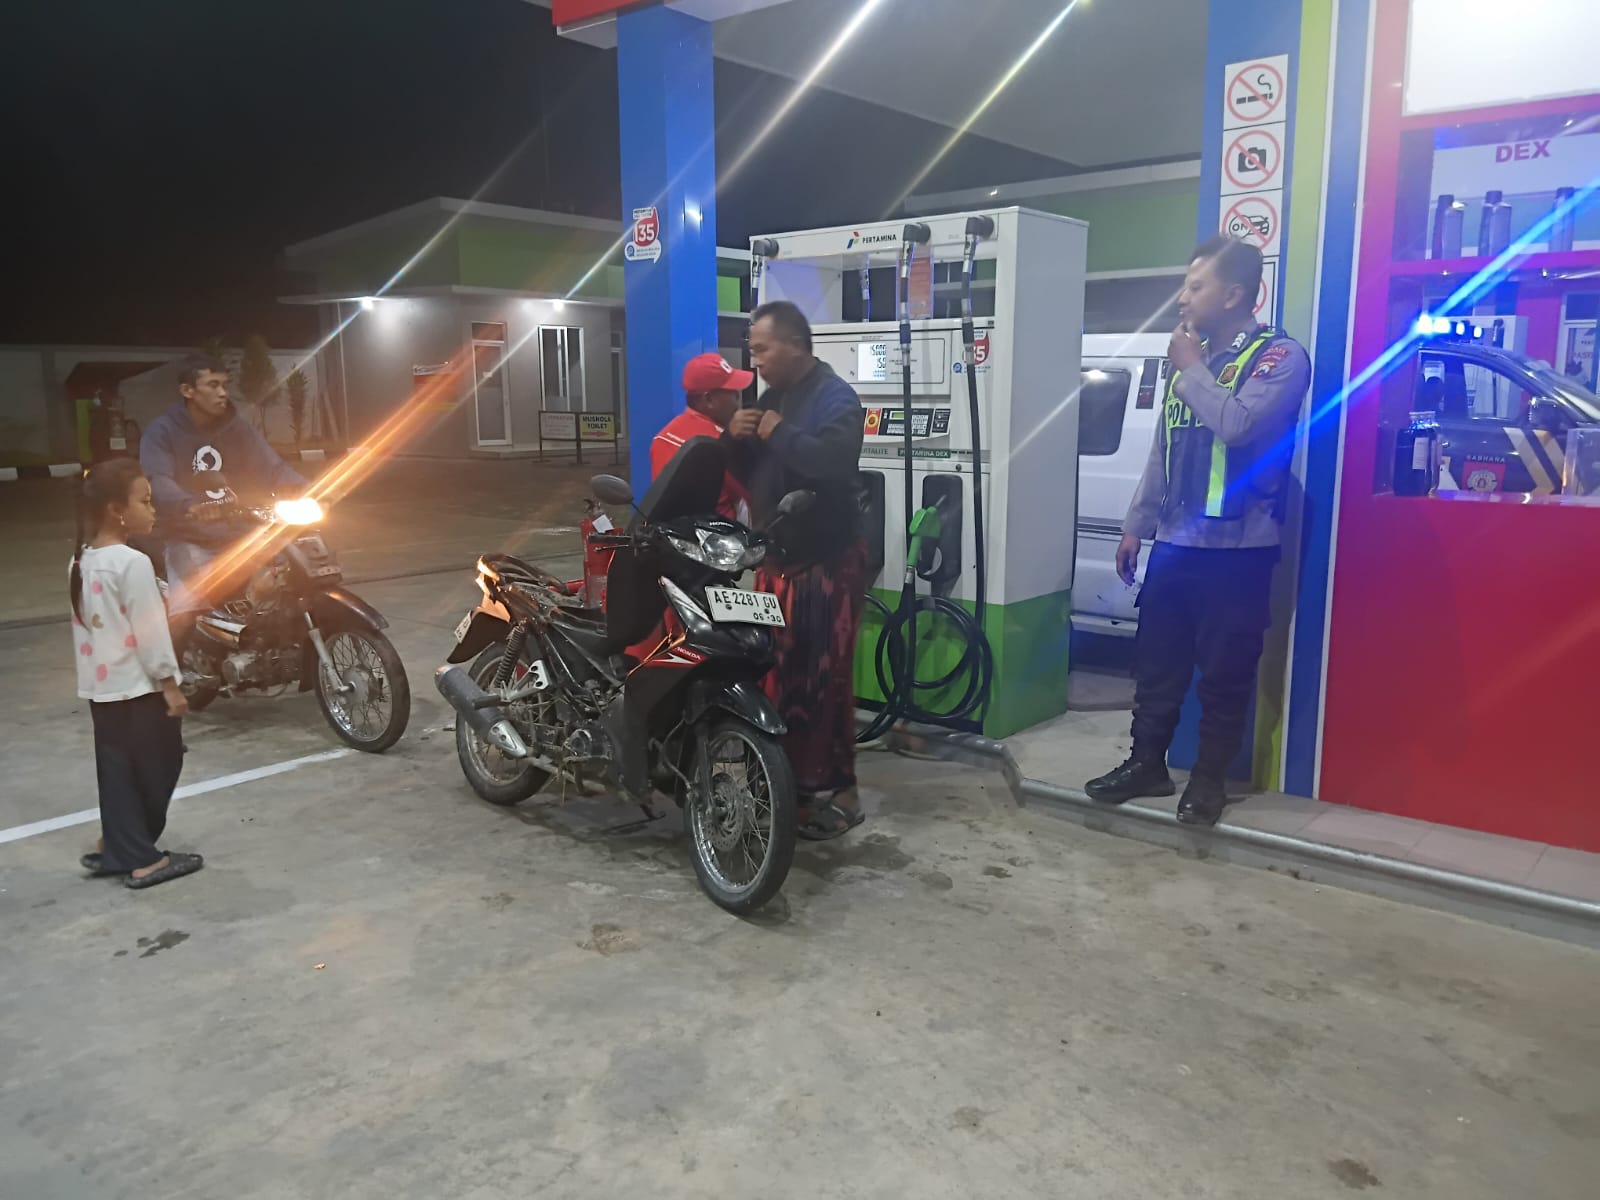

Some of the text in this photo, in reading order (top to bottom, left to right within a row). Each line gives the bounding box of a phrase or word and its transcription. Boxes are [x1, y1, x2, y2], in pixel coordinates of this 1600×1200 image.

[1495, 139, 1551, 163] DEX
[635, 223, 655, 242] 135
[862, 234, 897, 244] PERTAMINA
[714, 590, 731, 604] AE
[732, 592, 759, 607] 2281
[677, 646, 701, 660] HONDA
